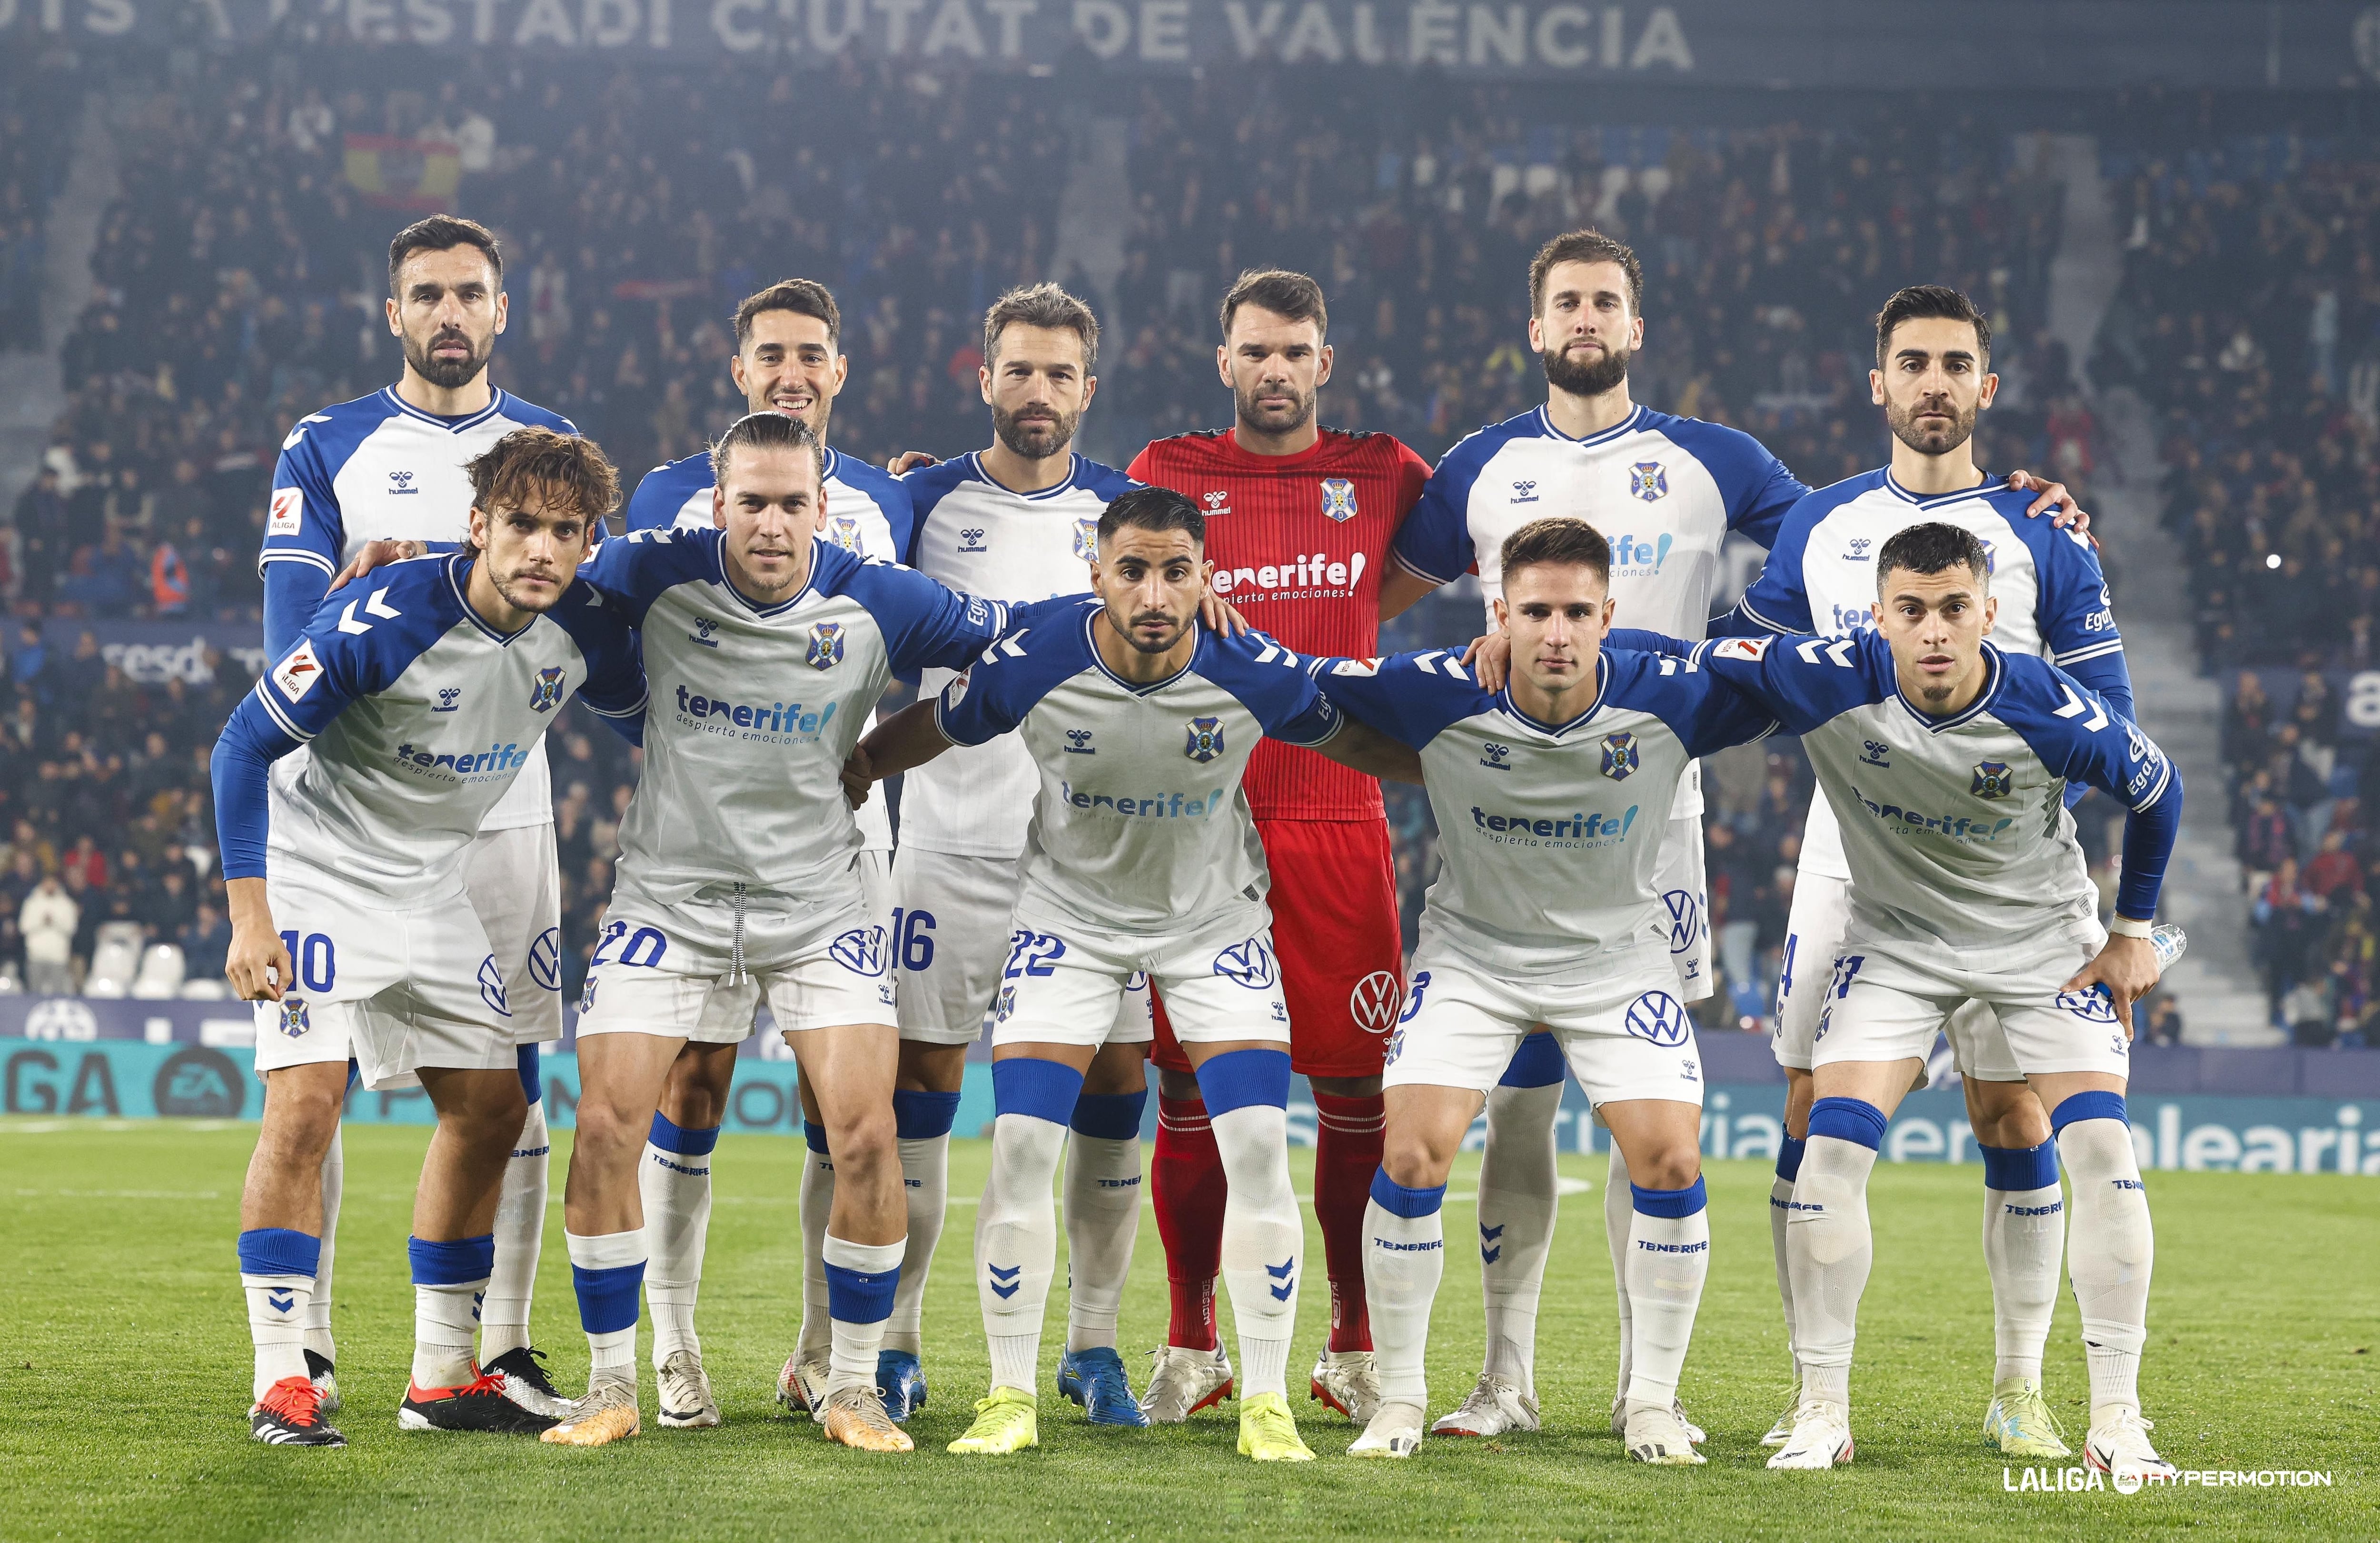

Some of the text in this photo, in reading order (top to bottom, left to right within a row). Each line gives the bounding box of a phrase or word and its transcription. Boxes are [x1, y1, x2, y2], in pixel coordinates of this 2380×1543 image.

[1072, 2, 1190, 61] DE
[1511, 495, 1539, 504] hummel
[1202, 506, 1231, 517] hummel
[1212, 552, 1366, 597] enerife!
[1609, 567, 1651, 577] ciones
[1271, 588, 1345, 601] emociones
[689, 634, 718, 648] hummel
[431, 704, 459, 712] hummel
[676, 685, 838, 742] tenerife!
[676, 714, 735, 738] despierta
[1064, 745, 1095, 754] hummel
[393, 756, 455, 782] despierta
[1480, 757, 1510, 771] hummel
[1471, 805, 1638, 842] tenerife!
[1476, 827, 1616, 849] despierta emociones
[591, 921, 667, 967] 20
[891, 907, 936, 971] 16
[280, 930, 335, 992] 10
[1005, 929, 1066, 980] 22
[1685, 971, 1699, 980] hummel
[1680, 1072, 1698, 1082] hummel
[653, 1153, 710, 1176] TENERIFE
[1374, 1237, 1443, 1251] TENERIFE
[1637, 1240, 1708, 1254] TENERIFE
